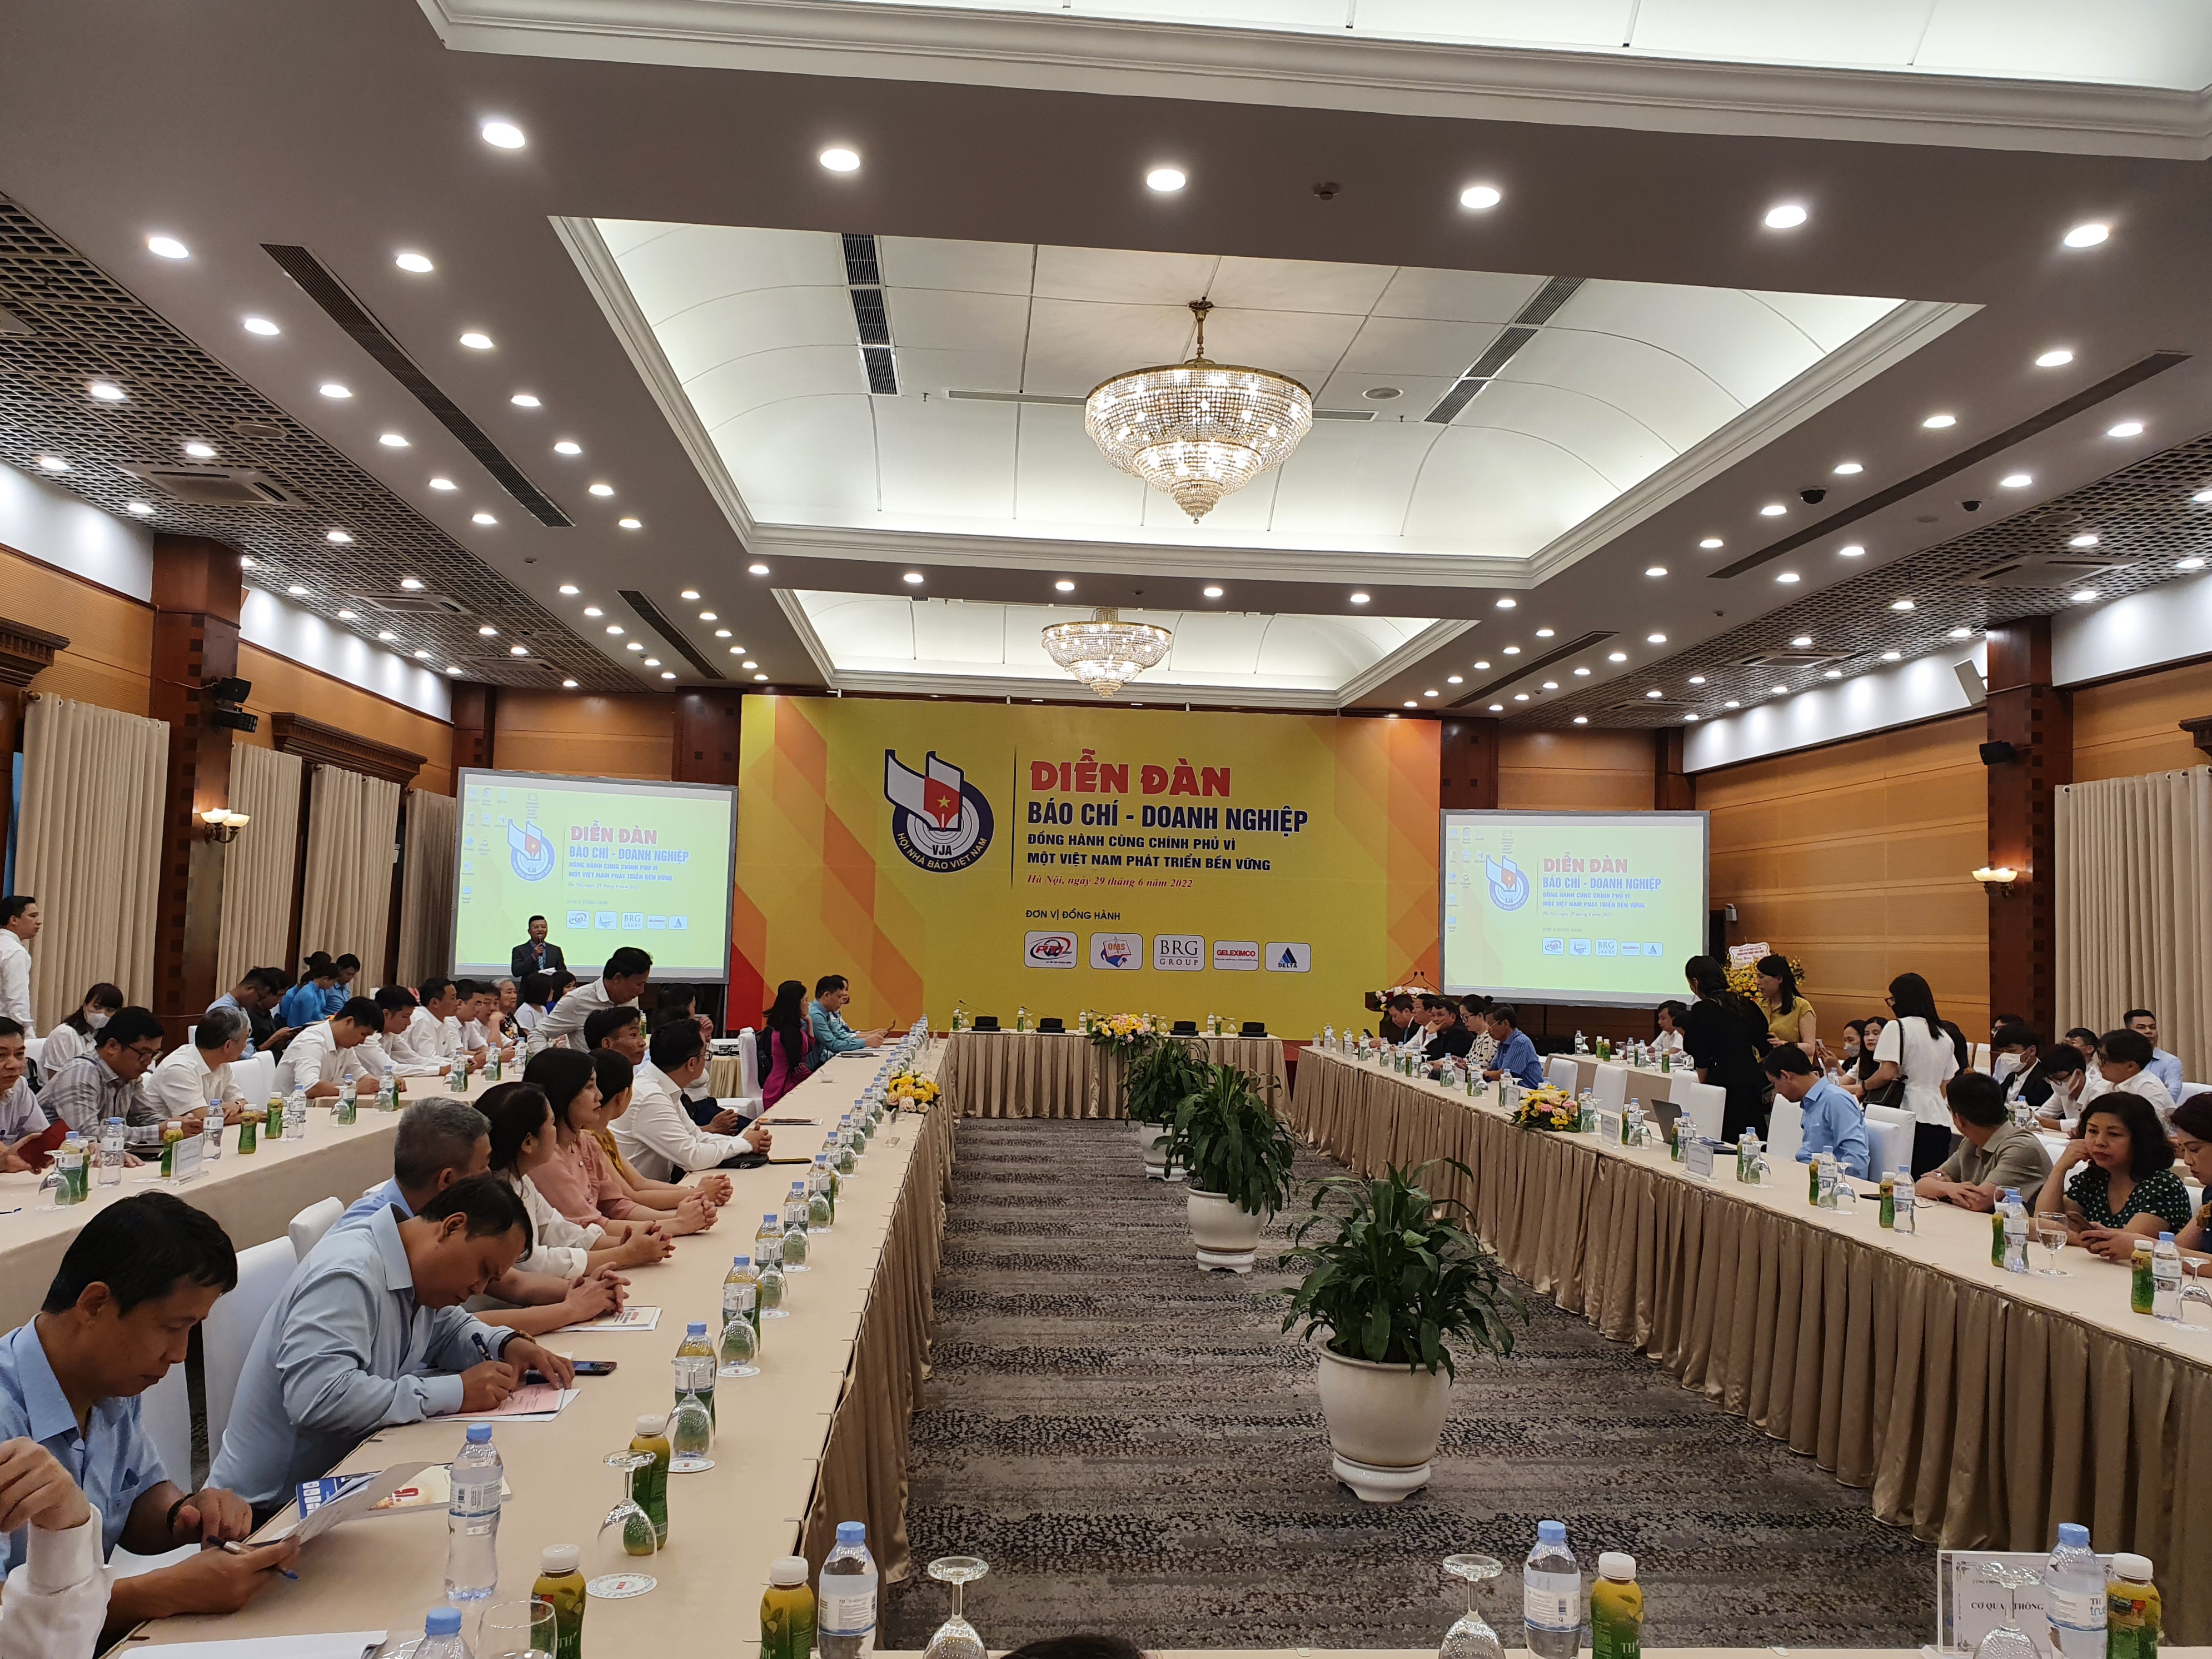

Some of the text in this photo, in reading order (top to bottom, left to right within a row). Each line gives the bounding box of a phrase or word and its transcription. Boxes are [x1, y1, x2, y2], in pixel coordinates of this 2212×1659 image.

[1030, 748, 1230, 797] DIỄN ĐÀN
[1028, 798, 1073, 826] BÁO
[1081, 799, 1119, 826] CHÍ
[1142, 805, 1218, 829] DOANH
[1225, 805, 1308, 837] NGHIỆP
[571, 820, 657, 845] DIỄN ĐÀN
[1068, 833, 1104, 846] HÀNH
[1109, 834, 1144, 847] CÙNG
[1149, 836, 1189, 849] CHÍNH
[1193, 836, 1219, 850] PHỦ
[1223, 838, 1235, 850] VÌ
[569, 844, 589, 858] BÁO
[592, 846, 609, 859] CHÍ
[619, 849, 651, 861] DOANH
[654, 849, 689, 865] NGHIỆP
[898, 833, 988, 869] HỘI NHÀ BÁO VIỆT NAM
[932, 845, 952, 856] VJA
[1028, 851, 1056, 866] MỘT
[1060, 852, 1088, 866] VIỆT
[1092, 855, 1122, 865] NAM
[1127, 854, 1159, 866] PHÁT
[1164, 853, 1201, 868] TRIỂN
[1235, 858, 1271, 870] VỮNG
[1543, 852, 1628, 873] DIỄN ĐÀN
[1028, 875, 1042, 883] Hà
[1045, 875, 1064, 885] Nội,
[1068, 876, 1091, 886] ngày
[1094, 876, 1105, 885] 29
[1108, 878, 1135, 888] tháng
[1170, 879, 1193, 888] 2022
[1543, 875, 1561, 888] BÁO
[1565, 875, 1581, 889] CHÍ
[1590, 878, 1622, 889] DOANH
[1626, 876, 1662, 891] NGHIỆP
[1025, 910, 1047, 918] ĐƠN
[1050, 909, 1059, 920] VỊ
[1094, 909, 1120, 920] HÀNH
[1160, 940, 1198, 955] BRG
[1986, 1602, 2006, 1611] QUA
[2013, 1601, 2044, 1611] THÔNG
[557, 1635, 573, 1648] TH
